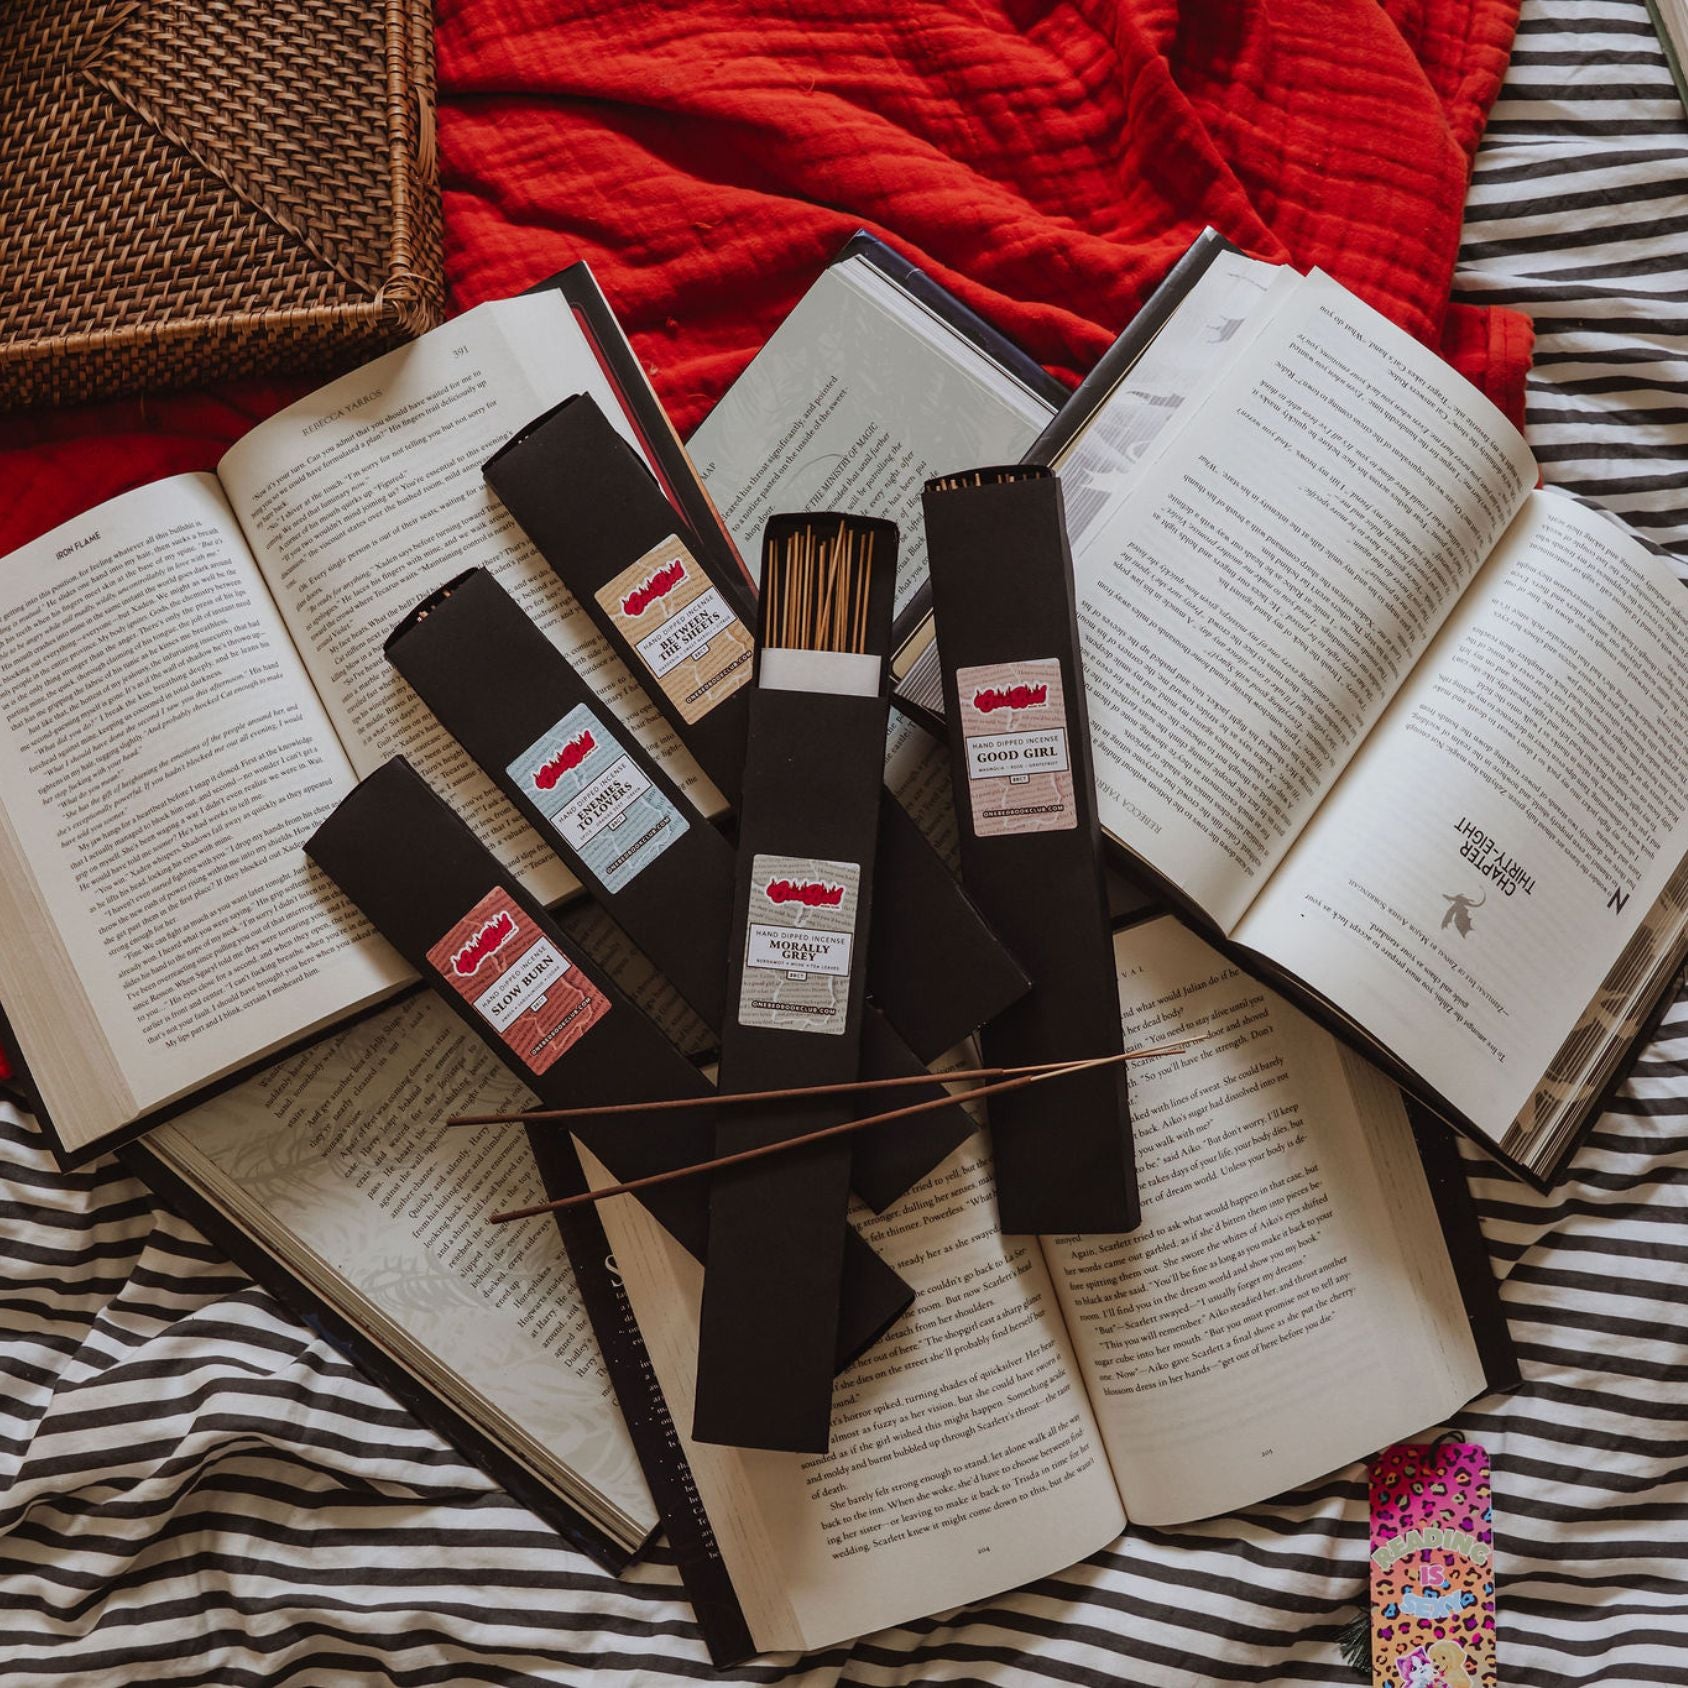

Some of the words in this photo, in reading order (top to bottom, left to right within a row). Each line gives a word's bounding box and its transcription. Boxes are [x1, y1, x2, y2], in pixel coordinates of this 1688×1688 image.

[1318, 305, 1335, 318] you
[1333, 315, 1344, 325] do
[451, 344, 469, 359] 391
[1406, 368, 1426, 386] takes
[1408, 384, 1436, 408] answers
[1426, 384, 1448, 406] Trager
[301, 408, 345, 436] REBECCA
[343, 388, 384, 412] YARROS
[818, 408, 831, 423] the
[1434, 406, 1448, 423] Cat
[812, 418, 822, 431] of
[794, 428, 815, 453] inside
[777, 462, 789, 474] on
[784, 450, 798, 464] the
[806, 488, 825, 507] THE
[820, 454, 851, 492] MINISTRY
[847, 443, 858, 459] OF
[854, 421, 878, 448] MAGIC
[759, 470, 781, 500] pasted
[846, 493, 860, 511] will
[855, 486, 867, 497] be
[864, 452, 895, 490] patrolling
[890, 440, 902, 455] the
[741, 496, 762, 520] notice
[730, 522, 741, 532] to
[738, 517, 745, 525] a
[743, 522, 761, 542] shop
[55, 544, 74, 560] IRON
[73, 530, 101, 550] FLAME
[1273, 557, 1300, 580] behind
[1299, 576, 1311, 588] far
[642, 633, 662, 650] HAND
[661, 615, 686, 636] DIPPED
[685, 592, 714, 617] INCENSE
[1329, 601, 1351, 622] others
[657, 641, 682, 661] THE
[681, 611, 720, 644] SHEETS
[658, 607, 710, 651] BETWEEN
[1350, 619, 1363, 635] The
[971, 740, 994, 749] HAND
[995, 737, 1024, 747] DIPPED
[1025, 734, 1059, 744] INCENSE
[976, 749, 1019, 763] GOOD
[1022, 745, 1058, 759] GIRL
[557, 805, 577, 823] HAND
[575, 785, 599, 807] DIPPED
[598, 761, 628, 788] INCENSE
[574, 777, 623, 821] ENEMIES
[576, 815, 593, 831] TO
[592, 781, 632, 818] LOVERS
[1120, 795, 1163, 835] REBECCA
[1451, 812, 1540, 896] THIRTY-EIGHT
[1455, 837, 1520, 898] CHAPTER
[755, 929, 779, 938] HAND
[780, 931, 809, 941] DIPPED
[810, 935, 845, 945] INCENSE
[768, 937, 831, 955] MORALLY
[781, 948, 817, 963] GREY
[1399, 946, 1416, 962] your
[1415, 959, 1424, 968] as
[481, 990, 500, 1008] HAND
[497, 969, 521, 992] DIPPED
[519, 944, 548, 971] INCENSE
[490, 983, 522, 1016] SLOW
[520, 954, 554, 987] BURN
[1423, 966, 1442, 984] chaos
[1438, 981, 1453, 994] and
[164, 1038, 177, 1048] My
[176, 1032, 190, 1043] lips
[189, 1024, 205, 1038] part
[204, 1016, 219, 1029] and
[217, 1013, 223, 1022] I
[241, 992, 267, 1009] certain
[265, 989, 272, 997] I
[270, 973, 304, 995] misheard
[1137, 1144, 1154, 1158] you
[1153, 1134, 1175, 1149] walk
[1175, 1126, 1195, 1141] with
[1097, 1238, 1132, 1253] Scarlett
[1132, 1228, 1155, 1244] tried
[1155, 1227, 1166, 1236] to
[1166, 1219, 1182, 1232] ask
[1181, 1213, 1203, 1226] what
[1203, 1199, 1229, 1217] would
[1228, 1190, 1259, 1208] happen
[1258, 1185, 1269, 1195] in
[881, 1324, 914, 1342] detach
[914, 1320, 937, 1332] from
[936, 1314, 953, 1325] her
[828, 1500, 846, 1511] She
[845, 1490, 874, 1506] barely
[874, 1485, 890, 1497] felt
[890, 1478, 920, 1492] strong
[919, 1466, 952, 1484] enough
[952, 1465, 963, 1473] to
[989, 1451, 1003, 1461] let
[1003, 1442, 1026, 1456] alone
[1026, 1431, 1047, 1446] walk
[1047, 1424, 1058, 1438] all
[1056, 1420, 1069, 1432] the
[871, 1532, 906, 1548] Scarlett
[905, 1525, 930, 1538] knew
[931, 1521, 940, 1530] it
[940, 1512, 967, 1527] might
[968, 1505, 992, 1519] come
[992, 1496, 1018, 1510] down
[1018, 1492, 1029, 1501] to
[1047, 1476, 1063, 1488] but
[1062, 1470, 1076, 1481] she
[977, 1545, 991, 1554] 204
[1369, 1526, 1491, 1571] READING
[1418, 1563, 1446, 1588] IS
[1398, 1588, 1465, 1619] SEXY
